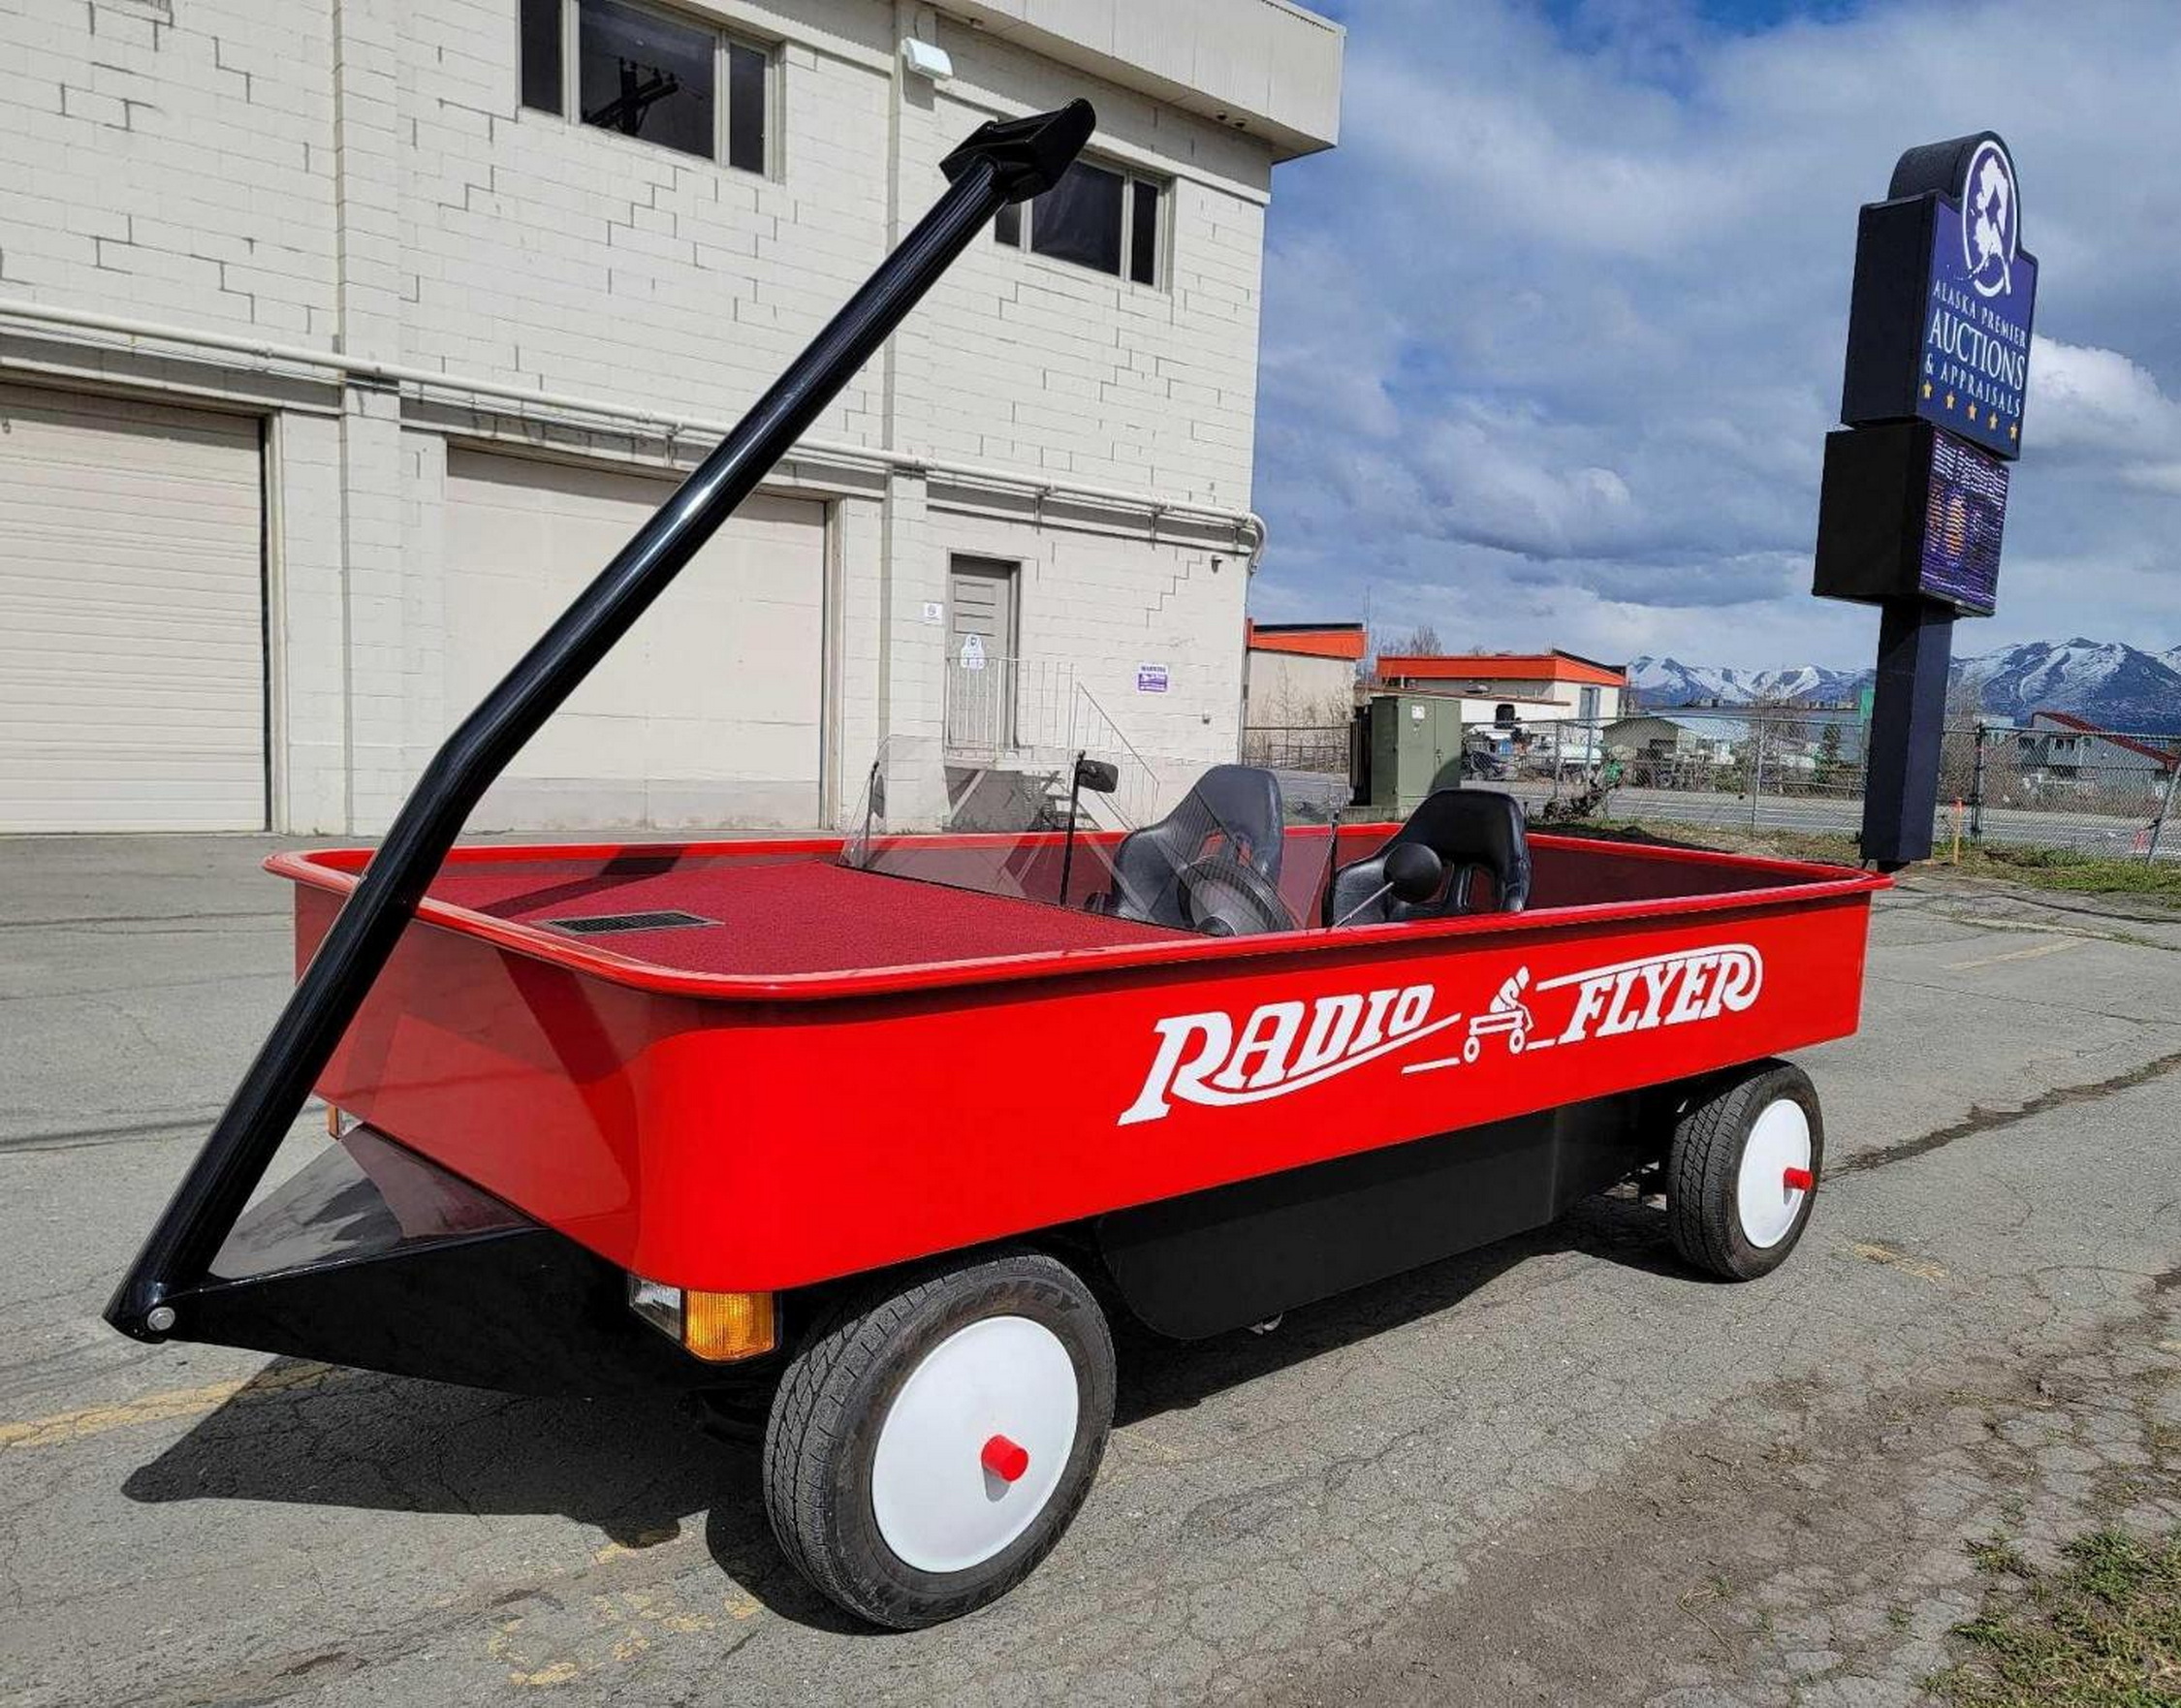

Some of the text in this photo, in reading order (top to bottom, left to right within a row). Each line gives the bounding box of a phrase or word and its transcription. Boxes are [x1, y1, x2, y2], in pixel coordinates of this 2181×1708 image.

[1928, 308, 2025, 391] AUCTIONS
[1933, 278, 2026, 349] ALASKA PREMIER
[1925, 353, 2020, 418] & APPRAISALS
[1117, 944, 1762, 1126] RADIO FLYER
